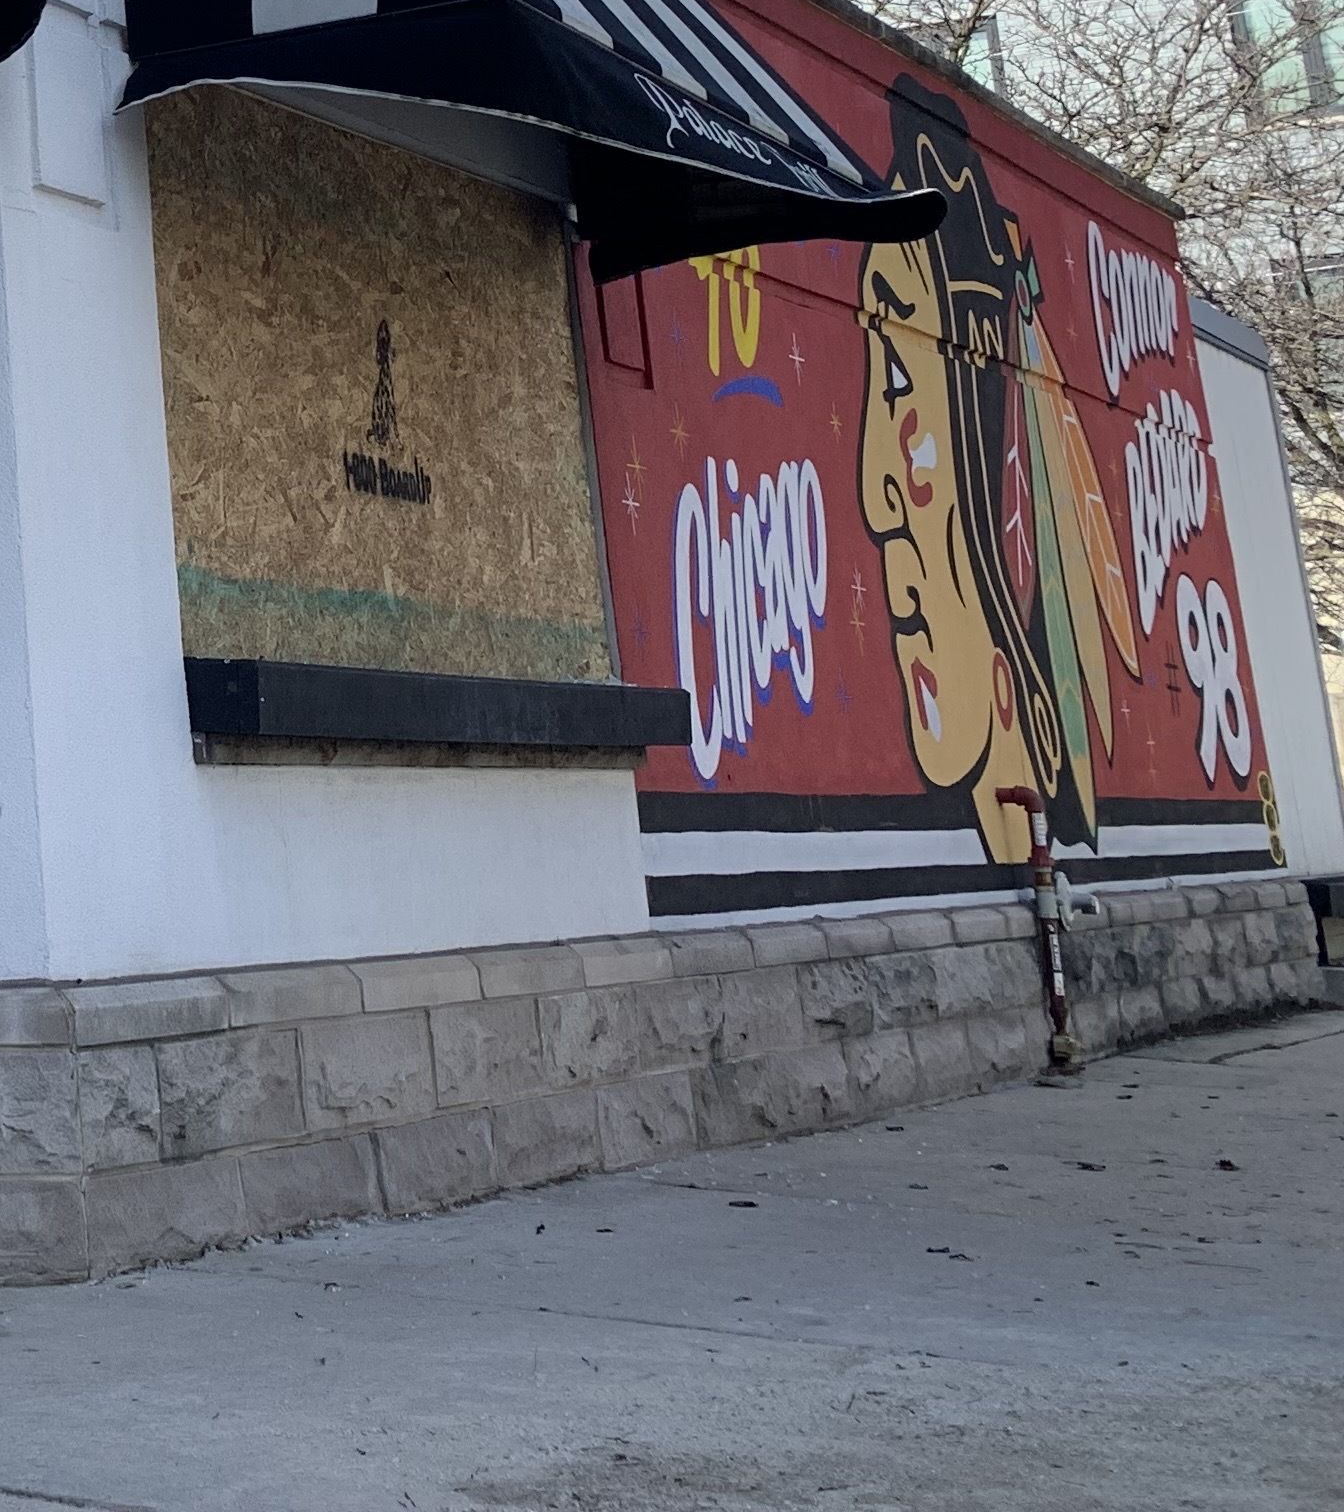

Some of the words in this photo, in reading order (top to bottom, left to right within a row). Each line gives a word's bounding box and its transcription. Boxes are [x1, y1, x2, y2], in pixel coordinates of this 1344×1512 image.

[633, 72, 772, 165] Palace
[1087, 219, 1179, 398] Connor
[674, 455, 828, 781] Chicago
